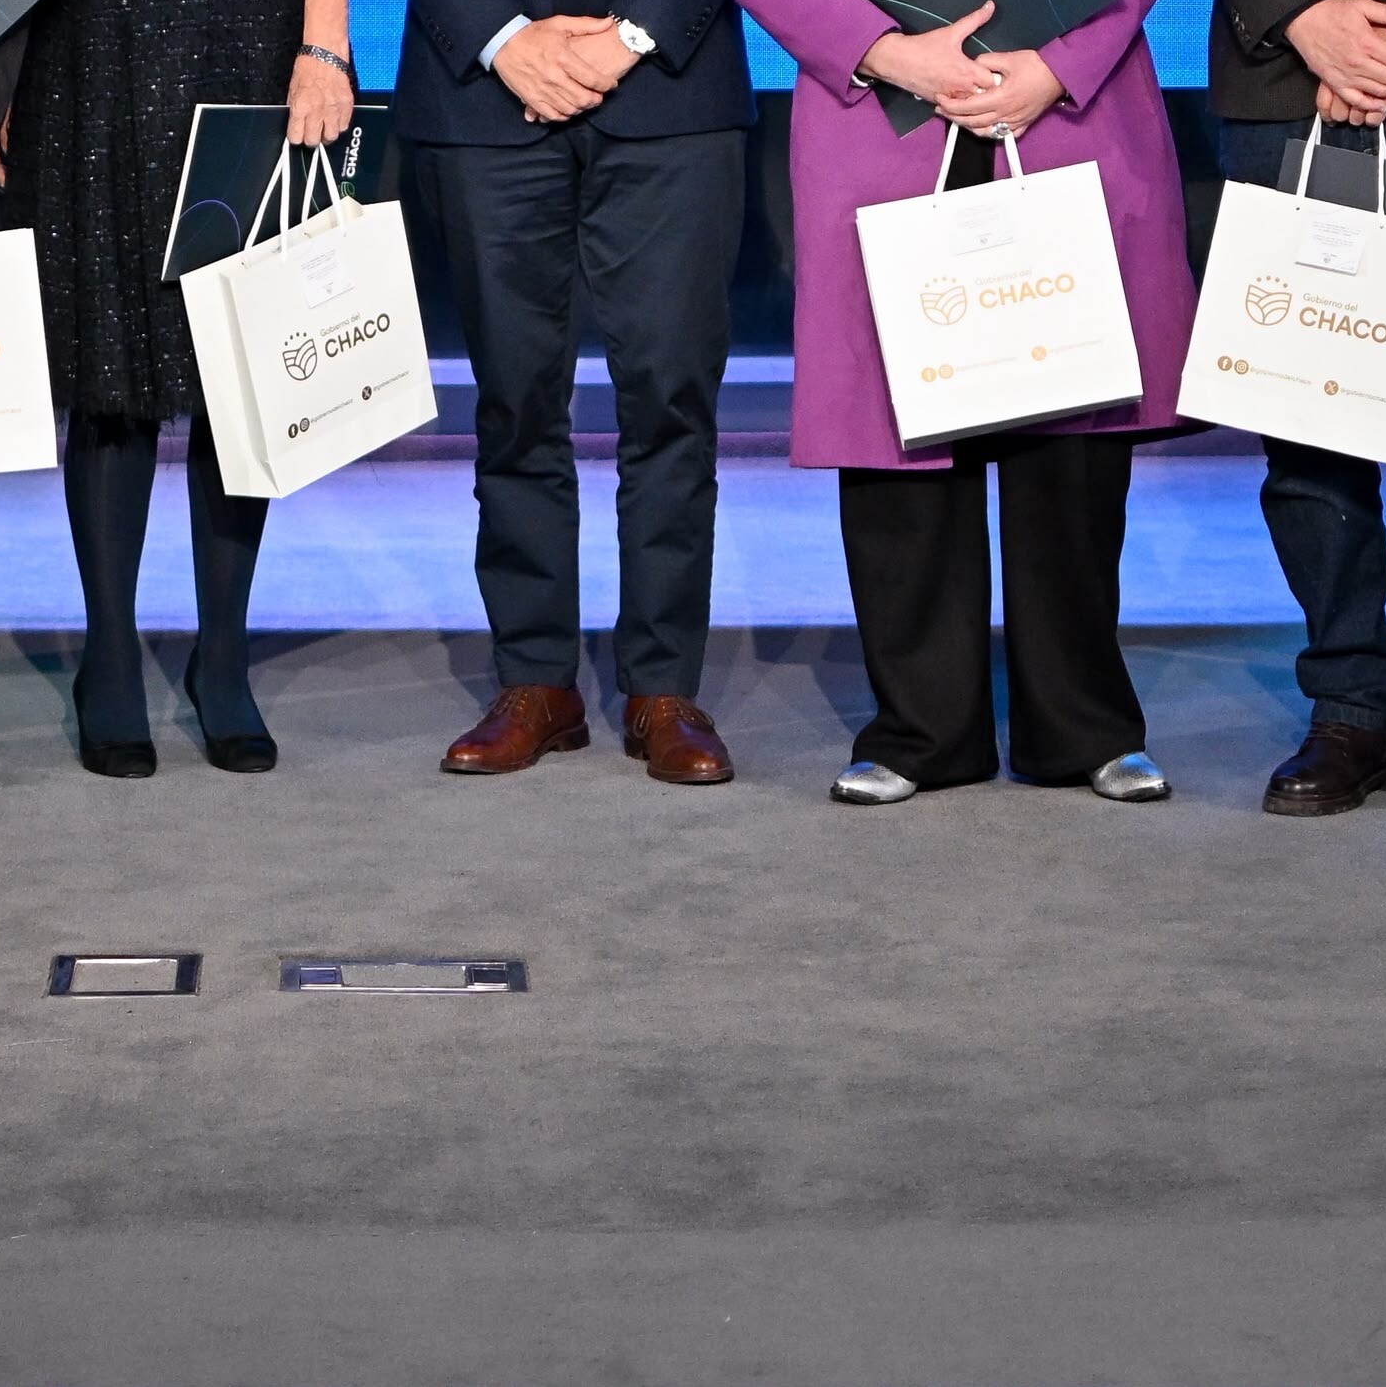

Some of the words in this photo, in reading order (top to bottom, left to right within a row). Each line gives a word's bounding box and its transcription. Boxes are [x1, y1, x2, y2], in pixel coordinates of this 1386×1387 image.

[346, 126, 363, 178] CHACO
[979, 273, 1076, 309] CHACO
[1303, 293, 1343, 309] Gobierno
[1344, 302, 1358, 312] del
[325, 313, 390, 358] CHACO
